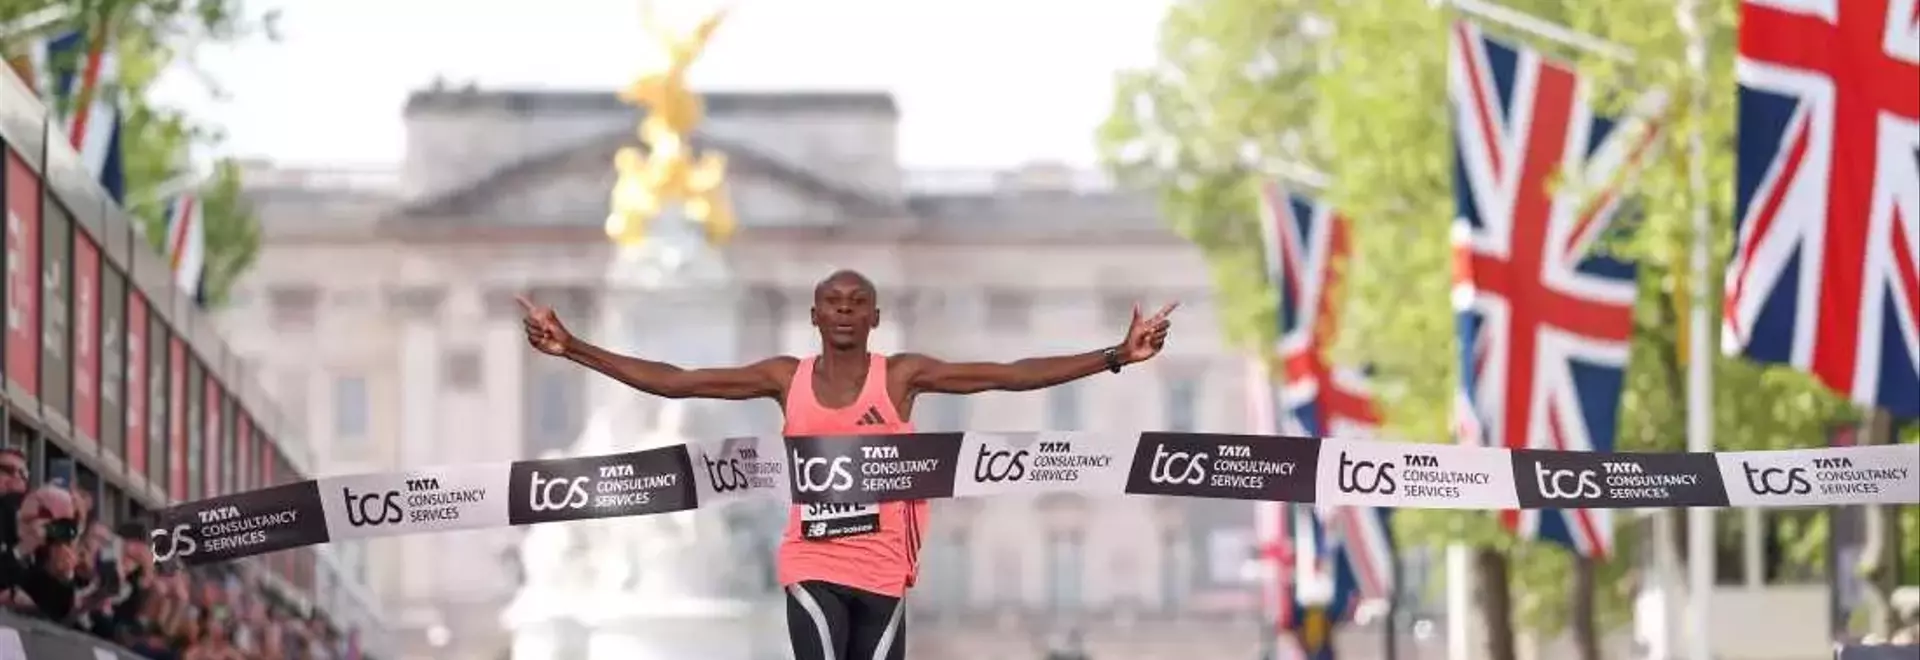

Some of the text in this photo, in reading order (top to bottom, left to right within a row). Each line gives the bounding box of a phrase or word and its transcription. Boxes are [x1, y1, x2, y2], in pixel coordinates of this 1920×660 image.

[861, 446, 899, 458] TATA
[1038, 441, 1071, 453] TATA
[1217, 445, 1250, 457] TATA
[861, 458, 938, 474] CONSULTANCY
[974, 443, 1029, 483] tcs
[1034, 454, 1112, 467] CONSULTANCY
[1150, 443, 1208, 485] tcs
[1213, 460, 1295, 476] CONSULTANCY
[1403, 455, 1438, 468] TATA
[1602, 462, 1643, 475] TATA
[1811, 458, 1852, 469] TATA
[599, 464, 633, 478] TATA
[793, 448, 854, 493] tcs
[1029, 469, 1079, 482] SERVICES
[1338, 450, 1396, 495] tcs
[1403, 469, 1490, 485] CONSULTANCY
[1743, 461, 1811, 496] tcs
[1815, 468, 1908, 482] CONSULTANCY
[406, 478, 440, 492] TATA
[597, 474, 677, 492] CONSULTANCY
[861, 476, 912, 491] SERVICES
[1210, 474, 1264, 489] SERVICES
[1535, 460, 1601, 499] tcs
[1605, 474, 1697, 488] CONSULTANCY
[529, 471, 590, 511] tcs
[1404, 484, 1460, 498] SERVICES
[1609, 487, 1670, 499] SERVICES
[1818, 482, 1878, 495] SERVICES
[407, 489, 486, 507] CONSULTANCY
[594, 491, 650, 507] SERVICES
[343, 487, 403, 526] tcs
[198, 506, 240, 524] TATA
[409, 507, 459, 523] SERVICES
[202, 510, 298, 537] CONSULTANCY
[150, 524, 196, 563] cs
[204, 530, 266, 552] SERVICES
